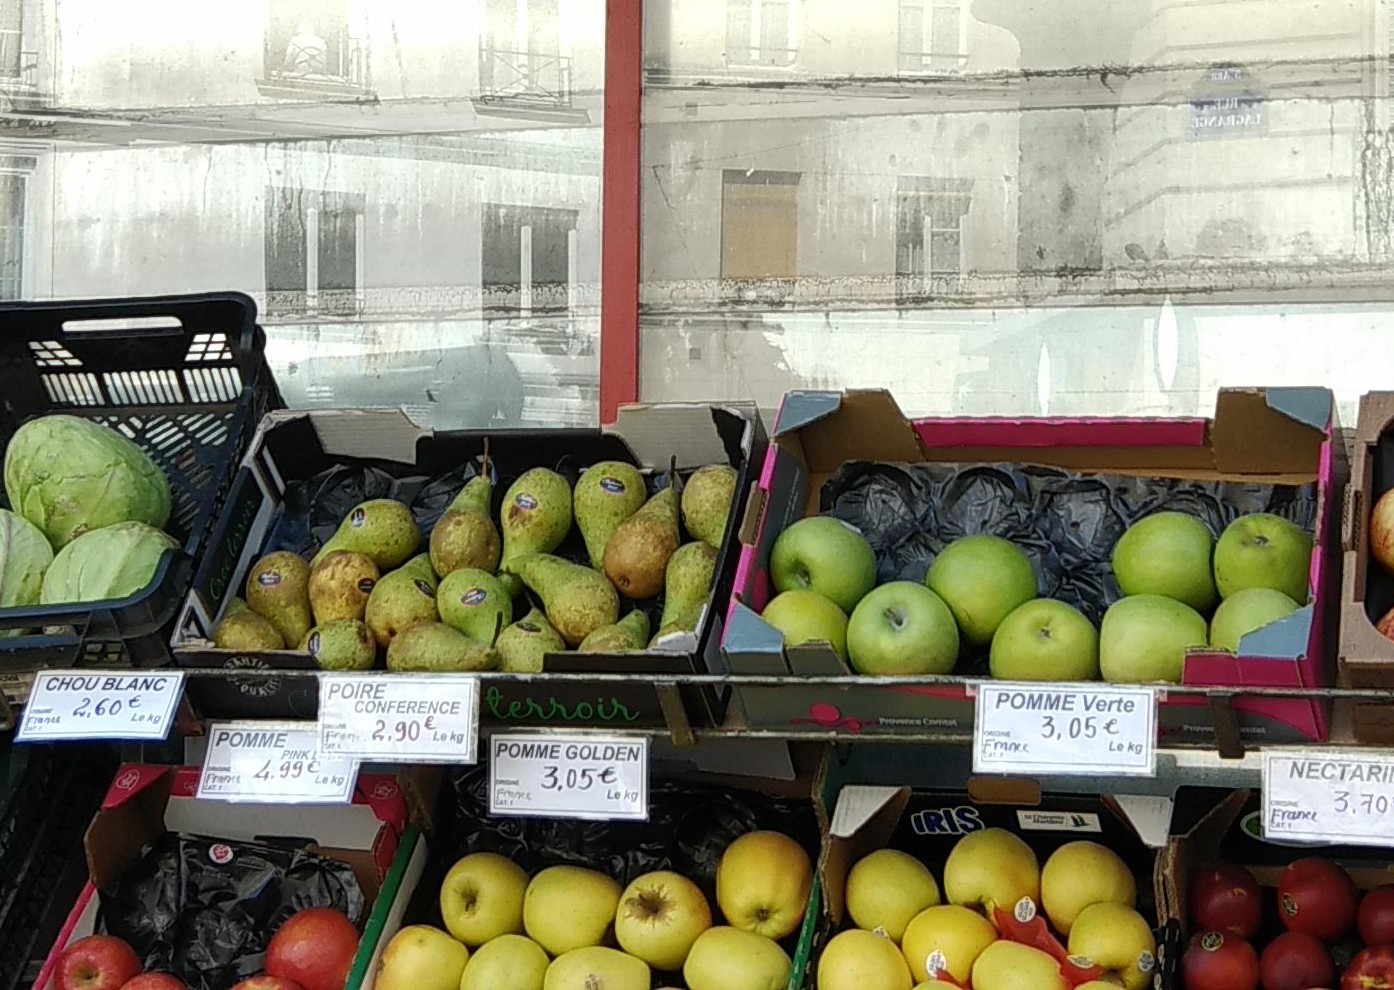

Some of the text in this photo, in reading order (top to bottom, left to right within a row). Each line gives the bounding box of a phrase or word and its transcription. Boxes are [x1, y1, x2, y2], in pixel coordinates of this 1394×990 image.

[45, 677, 167, 691] CHOU BLANC
[328, 682, 387, 699] POIRE
[354, 700, 461, 715] CONFERENCE
[486, 686, 640, 721] terroir
[995, 692, 1136, 713] POMME Verte
[131, 713, 161, 724] Le kg
[879, 717, 957, 727] Provence Comtat
[215, 731, 288, 748] POMME
[432, 731, 464, 744] Le kg
[280, 749, 311, 760] PINK
[496, 743, 641, 762] POMME GOLDEN
[1108, 741, 1143, 755] Le kg
[315, 774, 345, 786] Le kg
[607, 789, 638, 802] Le kg
[911, 806, 985, 835] IRIS
[1270, 808, 1318, 824] France
